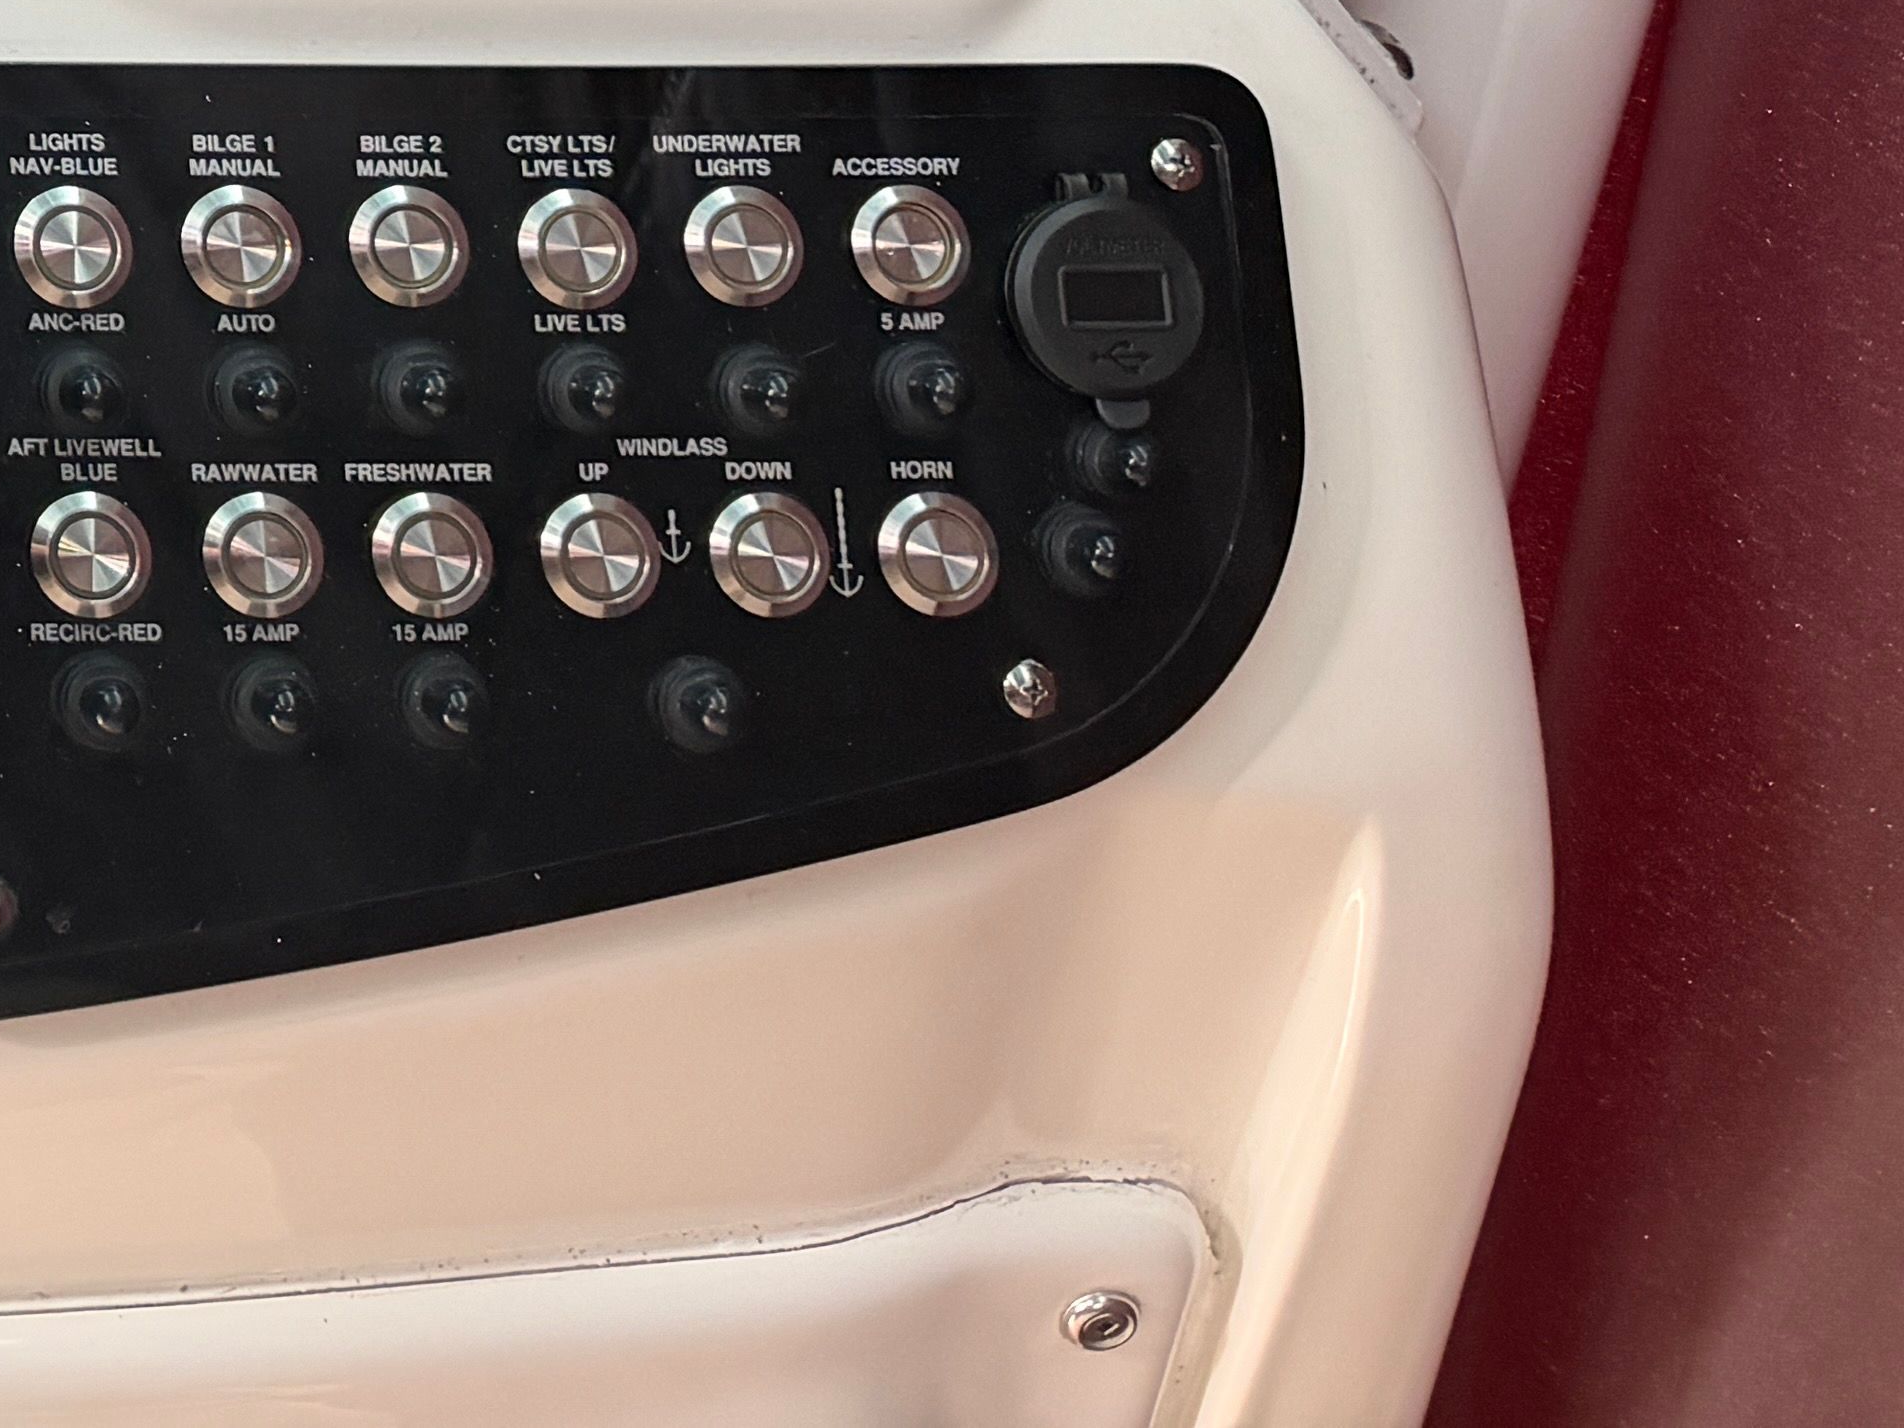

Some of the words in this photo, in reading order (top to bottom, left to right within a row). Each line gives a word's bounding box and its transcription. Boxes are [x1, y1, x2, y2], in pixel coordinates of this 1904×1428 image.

[30, 133, 105, 151] LIGHTS
[193, 135, 256, 152] BILGE
[263, 135, 275, 152] 1
[360, 135, 424, 152] BILGE
[429, 136, 442, 153] 2
[507, 135, 561, 153] CTSY
[653, 135, 800, 153] UNDERWATER
[10, 157, 118, 175] NAV-BLUE
[189, 159, 280, 176] MANUAL
[356, 159, 448, 177] MANUAL
[521, 160, 568, 177] LIVE
[573, 159, 613, 177] LTS
[695, 159, 771, 176] LIGHTS
[833, 157, 959, 175] ACCESSORY
[28, 313, 125, 332] ANC-RED
[218, 314, 275, 332] AUTO
[534, 314, 581, 332] LIVE
[587, 314, 626, 332] LTS
[881, 313, 893, 330] 5
[899, 312, 944, 330] AMP
[8, 438, 48, 456] AFT
[54, 439, 161, 457] LIVEWELL
[617, 437, 728, 456] WINDLASS
[61, 463, 117, 481] BLUE
[192, 464, 317, 482] RAWWATER
[345, 463, 492, 481] FRESHWATER
[579, 463, 608, 481] UP
[725, 462, 792, 480] DOWN
[890, 461, 953, 479] HORN
[30, 624, 162, 643] RECIRC-RED
[224, 624, 247, 642] 15
[253, 624, 299, 641] AMP
[392, 624, 416, 641] 15
[422, 623, 468, 641] AMP
